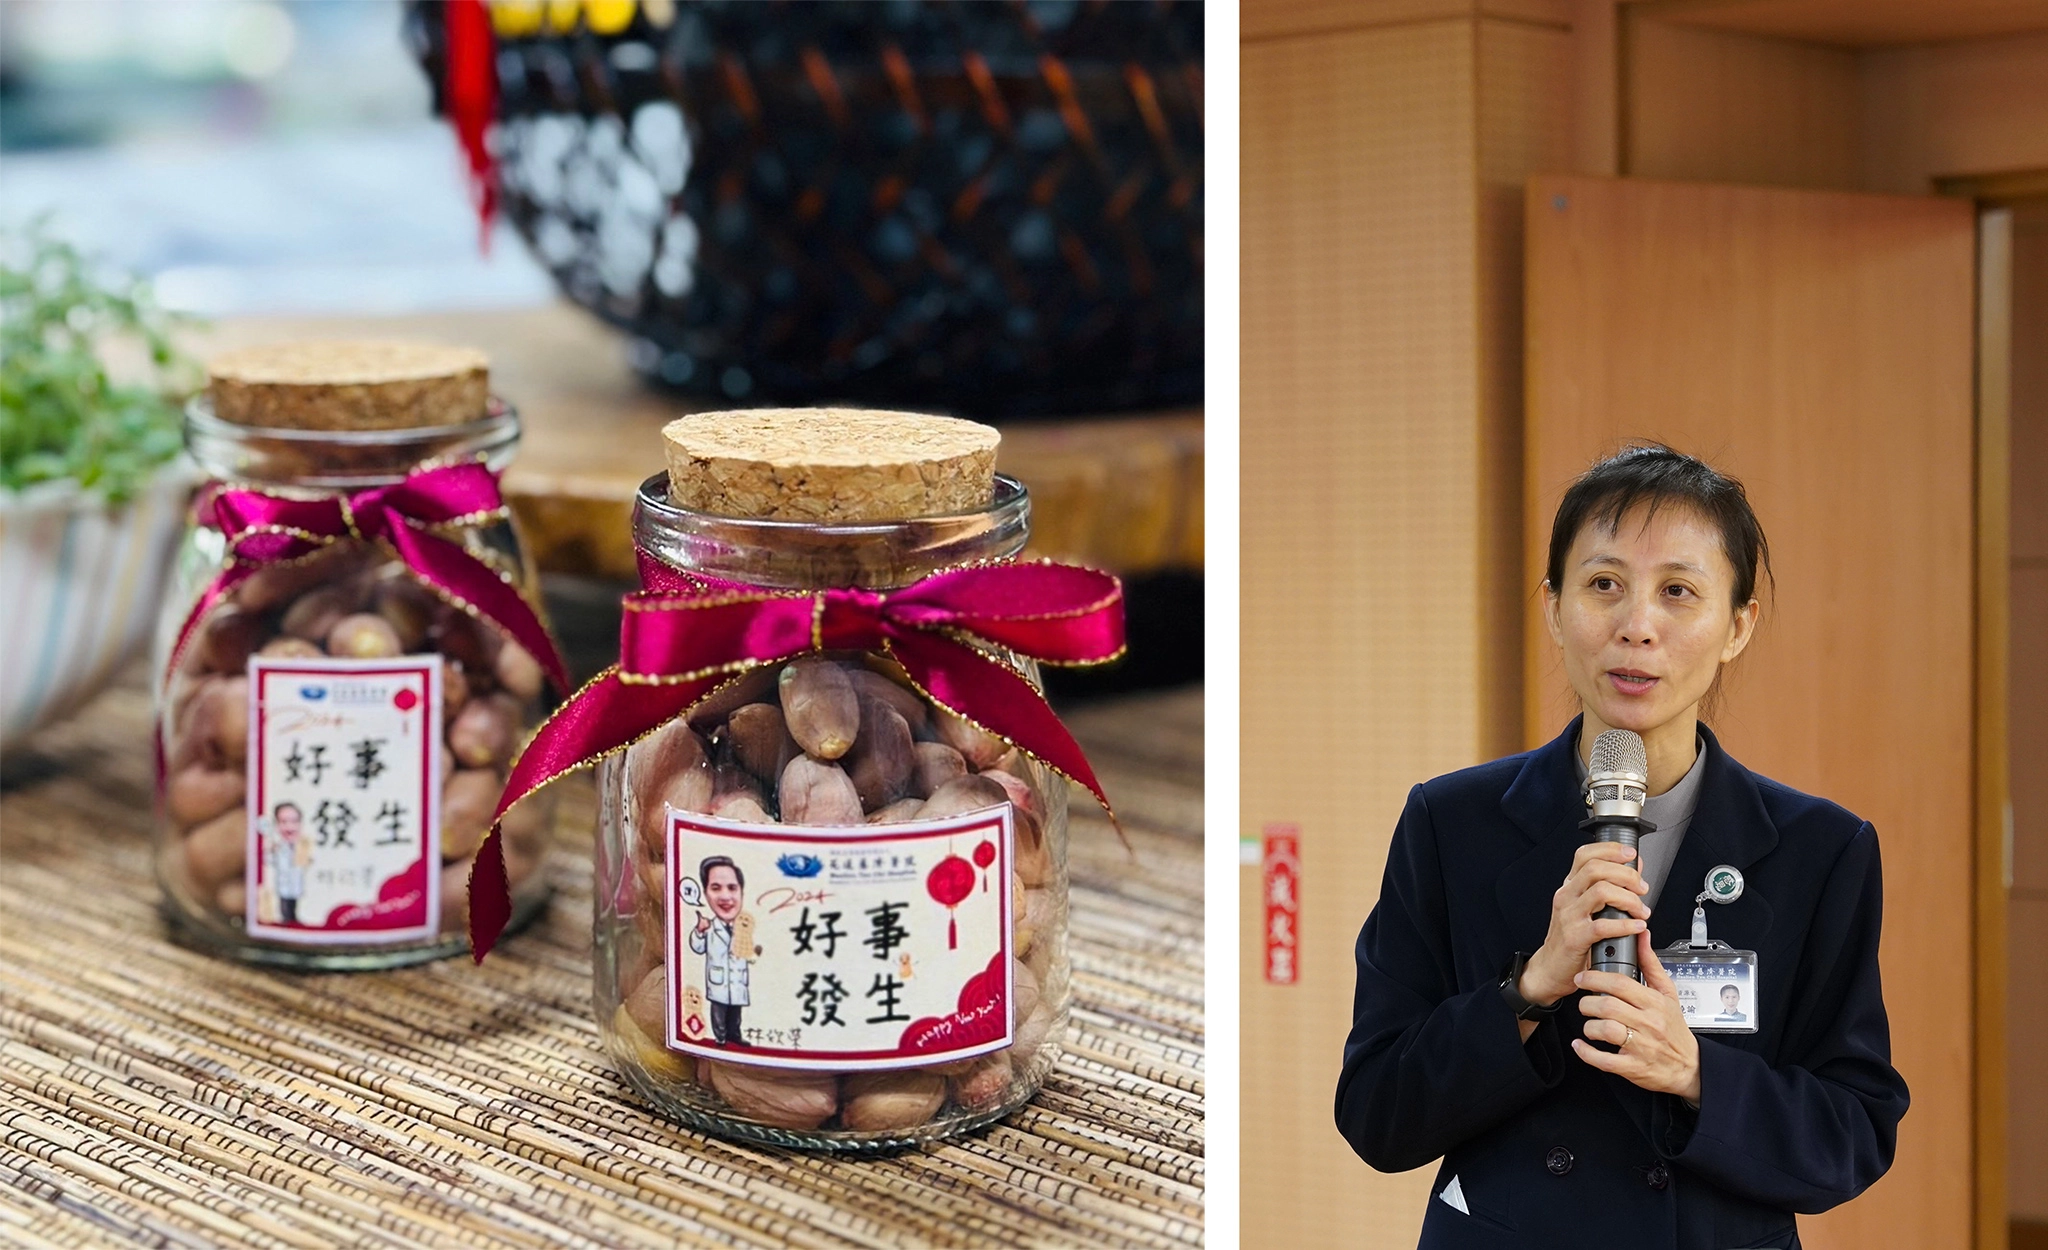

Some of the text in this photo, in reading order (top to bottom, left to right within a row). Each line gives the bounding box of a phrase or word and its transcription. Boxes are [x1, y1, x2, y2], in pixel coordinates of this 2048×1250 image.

[283, 738, 390, 789] 好事
[312, 800, 414, 849] 發生
[756, 887, 836, 914] 2024
[789, 900, 911, 962] 好事
[796, 973, 912, 1028] 發生
